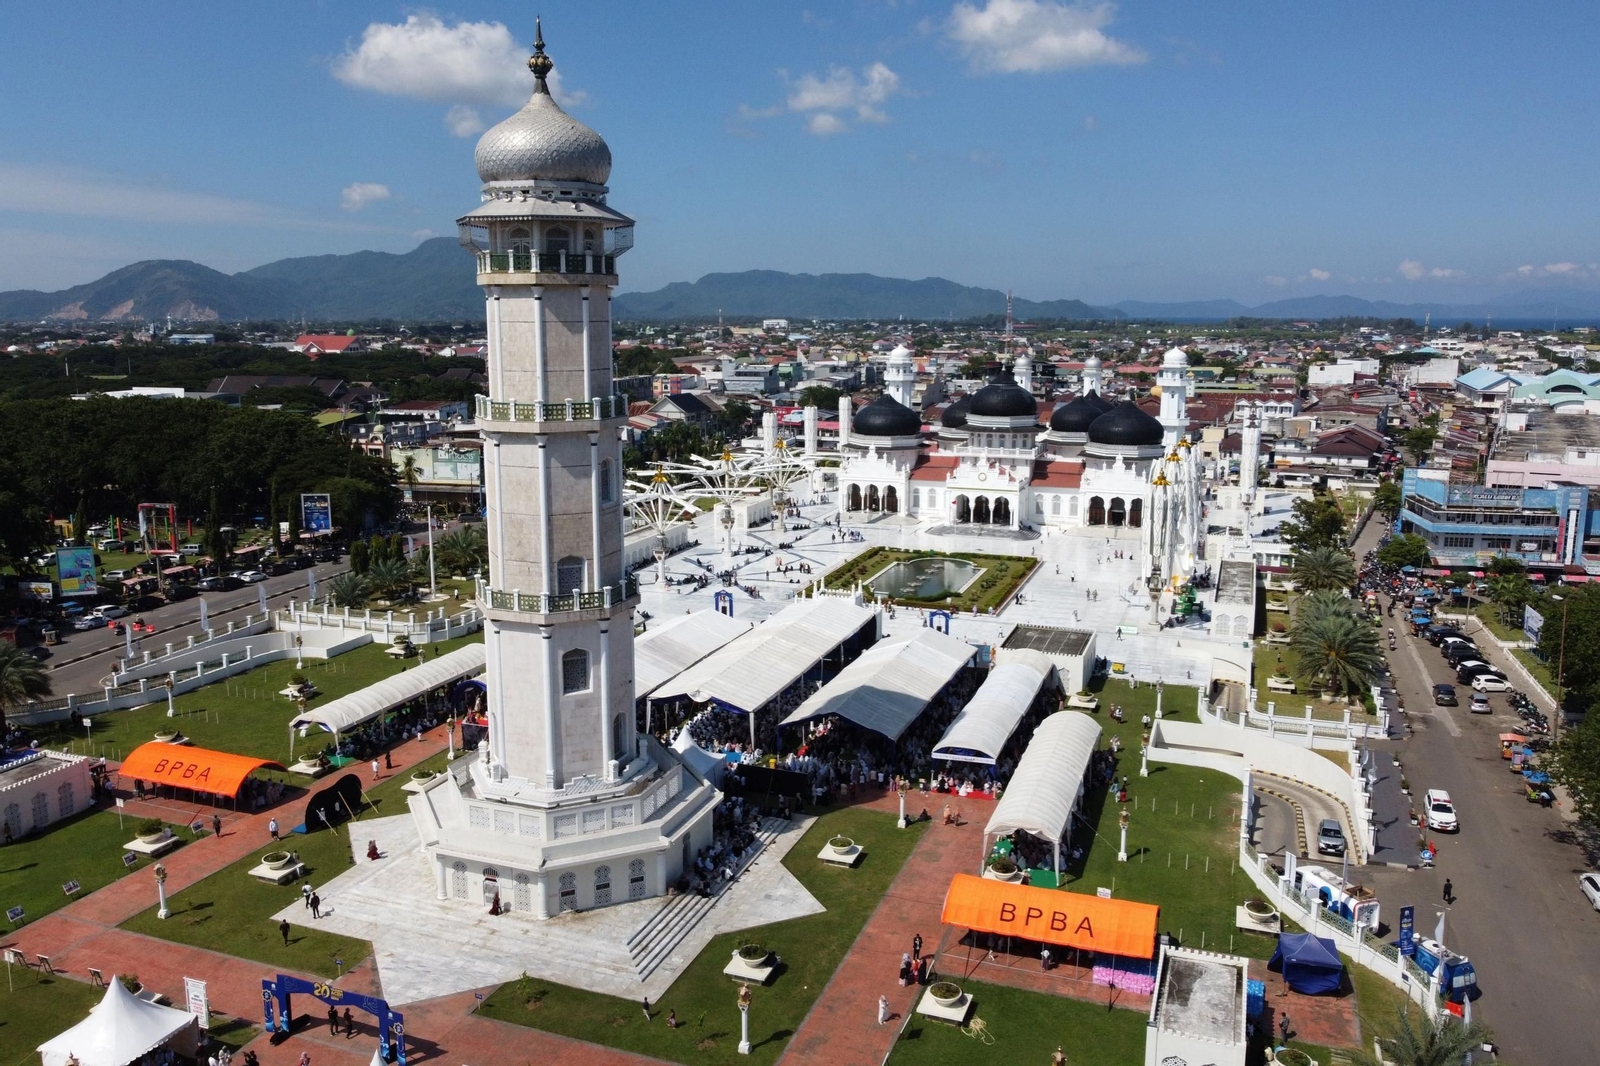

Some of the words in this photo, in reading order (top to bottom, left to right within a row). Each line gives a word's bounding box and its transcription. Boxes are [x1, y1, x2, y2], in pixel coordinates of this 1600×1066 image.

[154, 759, 211, 782] BPBA
[999, 902, 1094, 938] BPBA
[313, 982, 330, 998] 20
